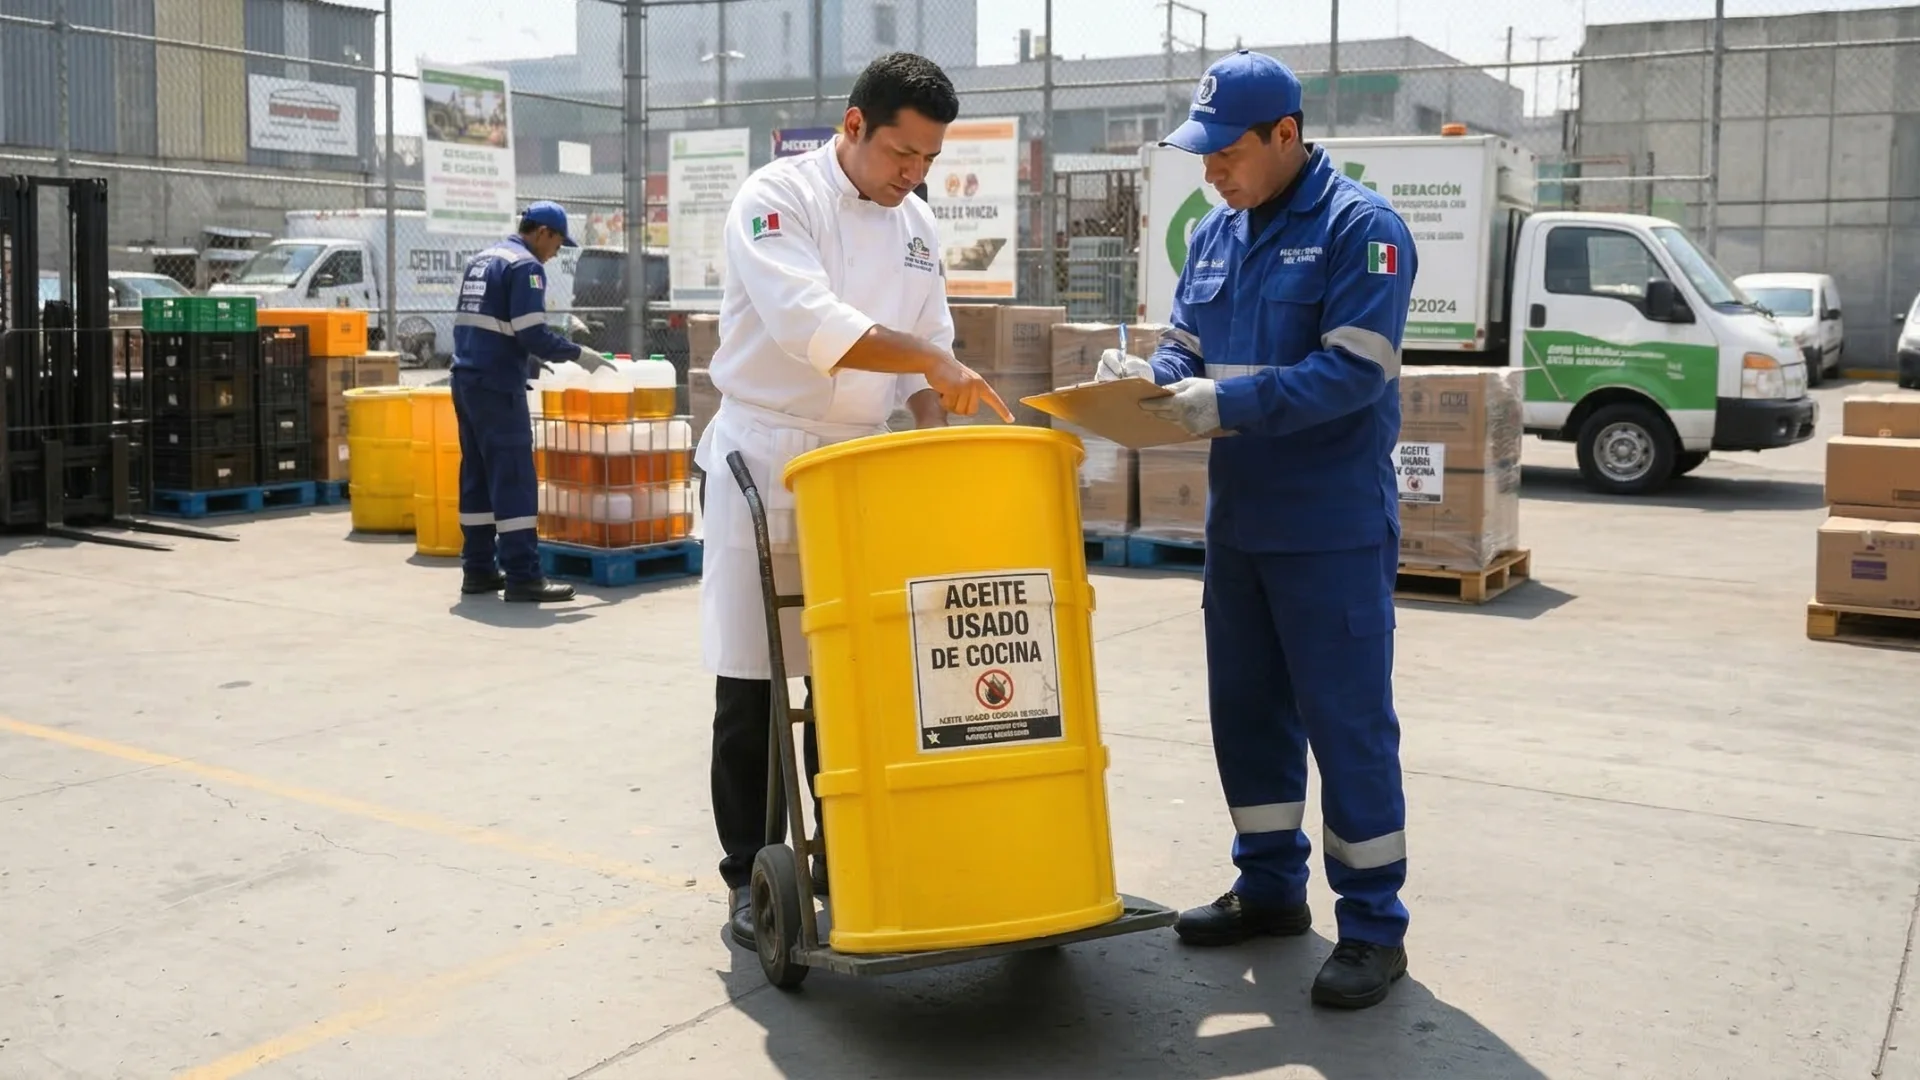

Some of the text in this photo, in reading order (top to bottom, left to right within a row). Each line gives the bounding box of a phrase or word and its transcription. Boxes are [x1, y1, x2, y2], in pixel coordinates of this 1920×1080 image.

[944, 580, 1028, 610] ACEITE
[947, 610, 1030, 640] USADO
[931, 640, 1042, 670] DE COCINA
